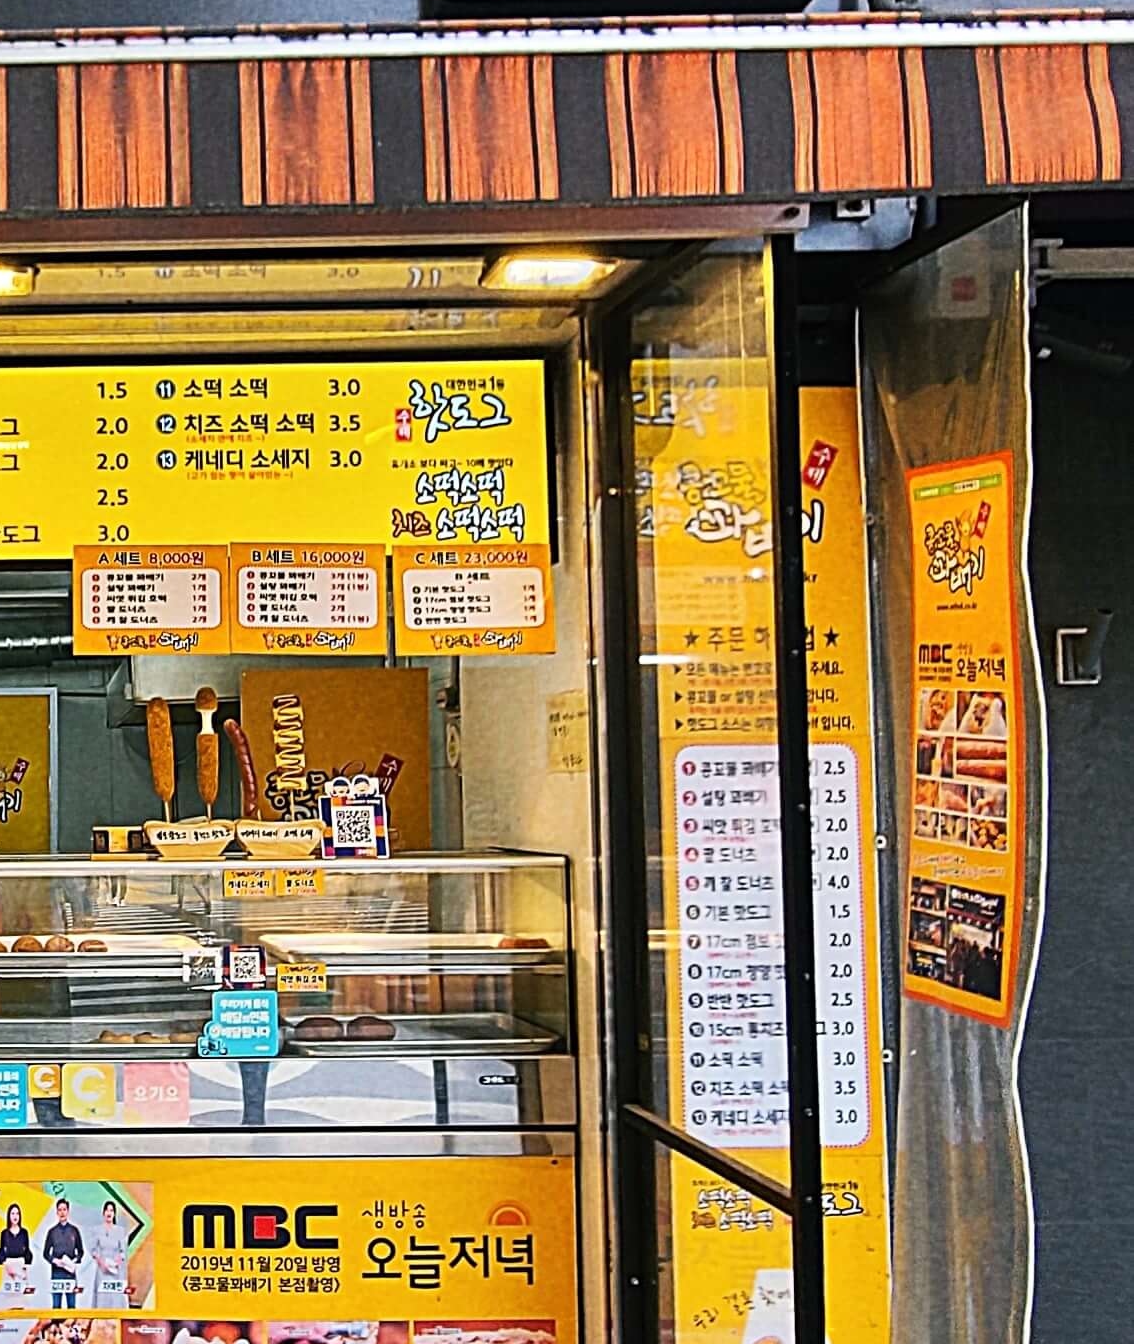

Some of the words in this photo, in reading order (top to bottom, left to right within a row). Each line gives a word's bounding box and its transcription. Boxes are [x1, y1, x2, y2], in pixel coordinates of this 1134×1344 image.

[96, 381, 128, 400] 1.5
[183, 378, 223, 399] 소떡
[229, 377, 269, 399] 소떡
[328, 378, 361, 397] 3.0
[409, 379, 513, 444] 핫도그
[96, 417, 129, 435] 2.0
[184, 413, 224, 435] 치즈
[229, 413, 269, 434] 소떡
[275, 412, 315, 433] 소떡
[329, 414, 361, 432] 3.5
[96, 452, 129, 471] 2.0
[184, 448, 244, 471] 케네디
[250, 447, 310, 469] 소세지
[329, 449, 362, 468] 3.0
[416, 466, 505, 507] 소떡소떡
[96, 488, 129, 507] 2.5
[436, 503, 525, 543] 소떡소떡
[97, 524, 130, 542] 3.0
[98, 552, 110, 565] A
[113, 551, 142, 565] 세트
[148, 551, 205, 567] 8,000원
[252, 550, 262, 563] B
[265, 550, 294, 564] 세트
[300, 550, 365, 567] 16,000원
[415, 552, 426, 565] C
[429, 550, 459, 565] 세트
[464, 551, 528, 566] 23,000원
[928, 545, 985, 596] 꽈배기
[918, 643, 953, 664] MBC
[955, 656, 1006, 682] 오늘저녁
[824, 760, 846, 775] 2.5
[825, 789, 847, 804] 2.5
[826, 818, 848, 832] 2.0
[826, 846, 849, 861] 2.0
[827, 875, 850, 889] 4.0
[829, 904, 851, 919] 1.5
[829, 933, 852, 947] 2.0
[830, 964, 853, 978] 2.0
[831, 993, 853, 1007] 2.5
[708, 1022, 743, 1037] 15cm
[832, 1021, 854, 1036] 3.0
[833, 1052, 856, 1066] 3.0
[834, 1080, 857, 1095] 3.5
[835, 1109, 857, 1124] 3.0
[361, 1200, 427, 1229] 생방송
[182, 1204, 339, 1250] MBC
[180, 1255, 234, 1273] 2019년
[238, 1255, 271, 1273] 11월
[274, 1255, 308, 1272] 20일
[312, 1255, 341, 1273] 방영
[361, 1233, 536, 1290] 오늘저녁
